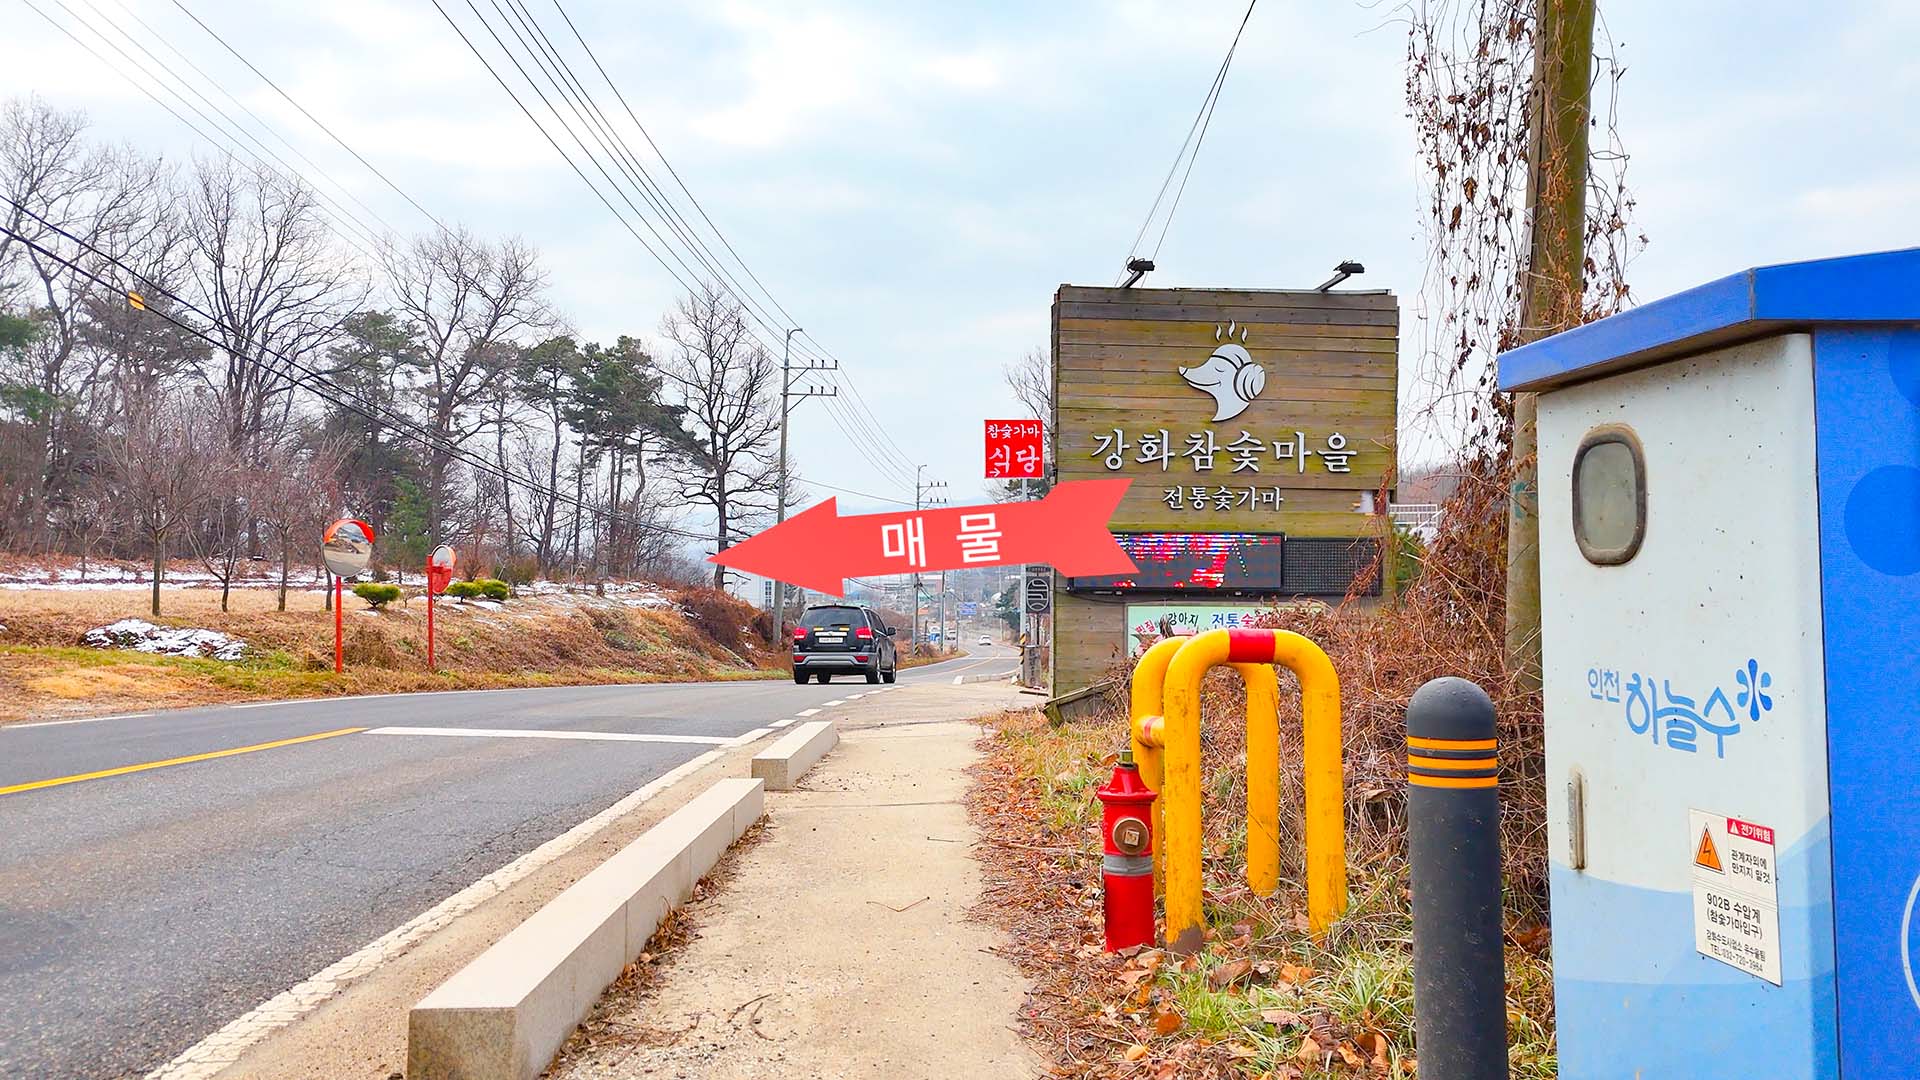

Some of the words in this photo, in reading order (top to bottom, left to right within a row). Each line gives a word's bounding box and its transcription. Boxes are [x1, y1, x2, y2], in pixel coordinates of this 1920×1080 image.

[987, 423, 1041, 440] 참숯가마
[988, 444, 1041, 474] 식당
[1090, 428, 1358, 474] 강화참숯마을
[1162, 484, 1285, 512] 전통숯가마
[1587, 668, 1621, 704] 인천
[1625, 672, 1741, 760] 하늘수
[1740, 823, 1771, 843] 전기위험
[1731, 861, 1754, 880] 만지지
[1706, 892, 1731, 912] 902B
[1733, 901, 1761, 925] 수압계
